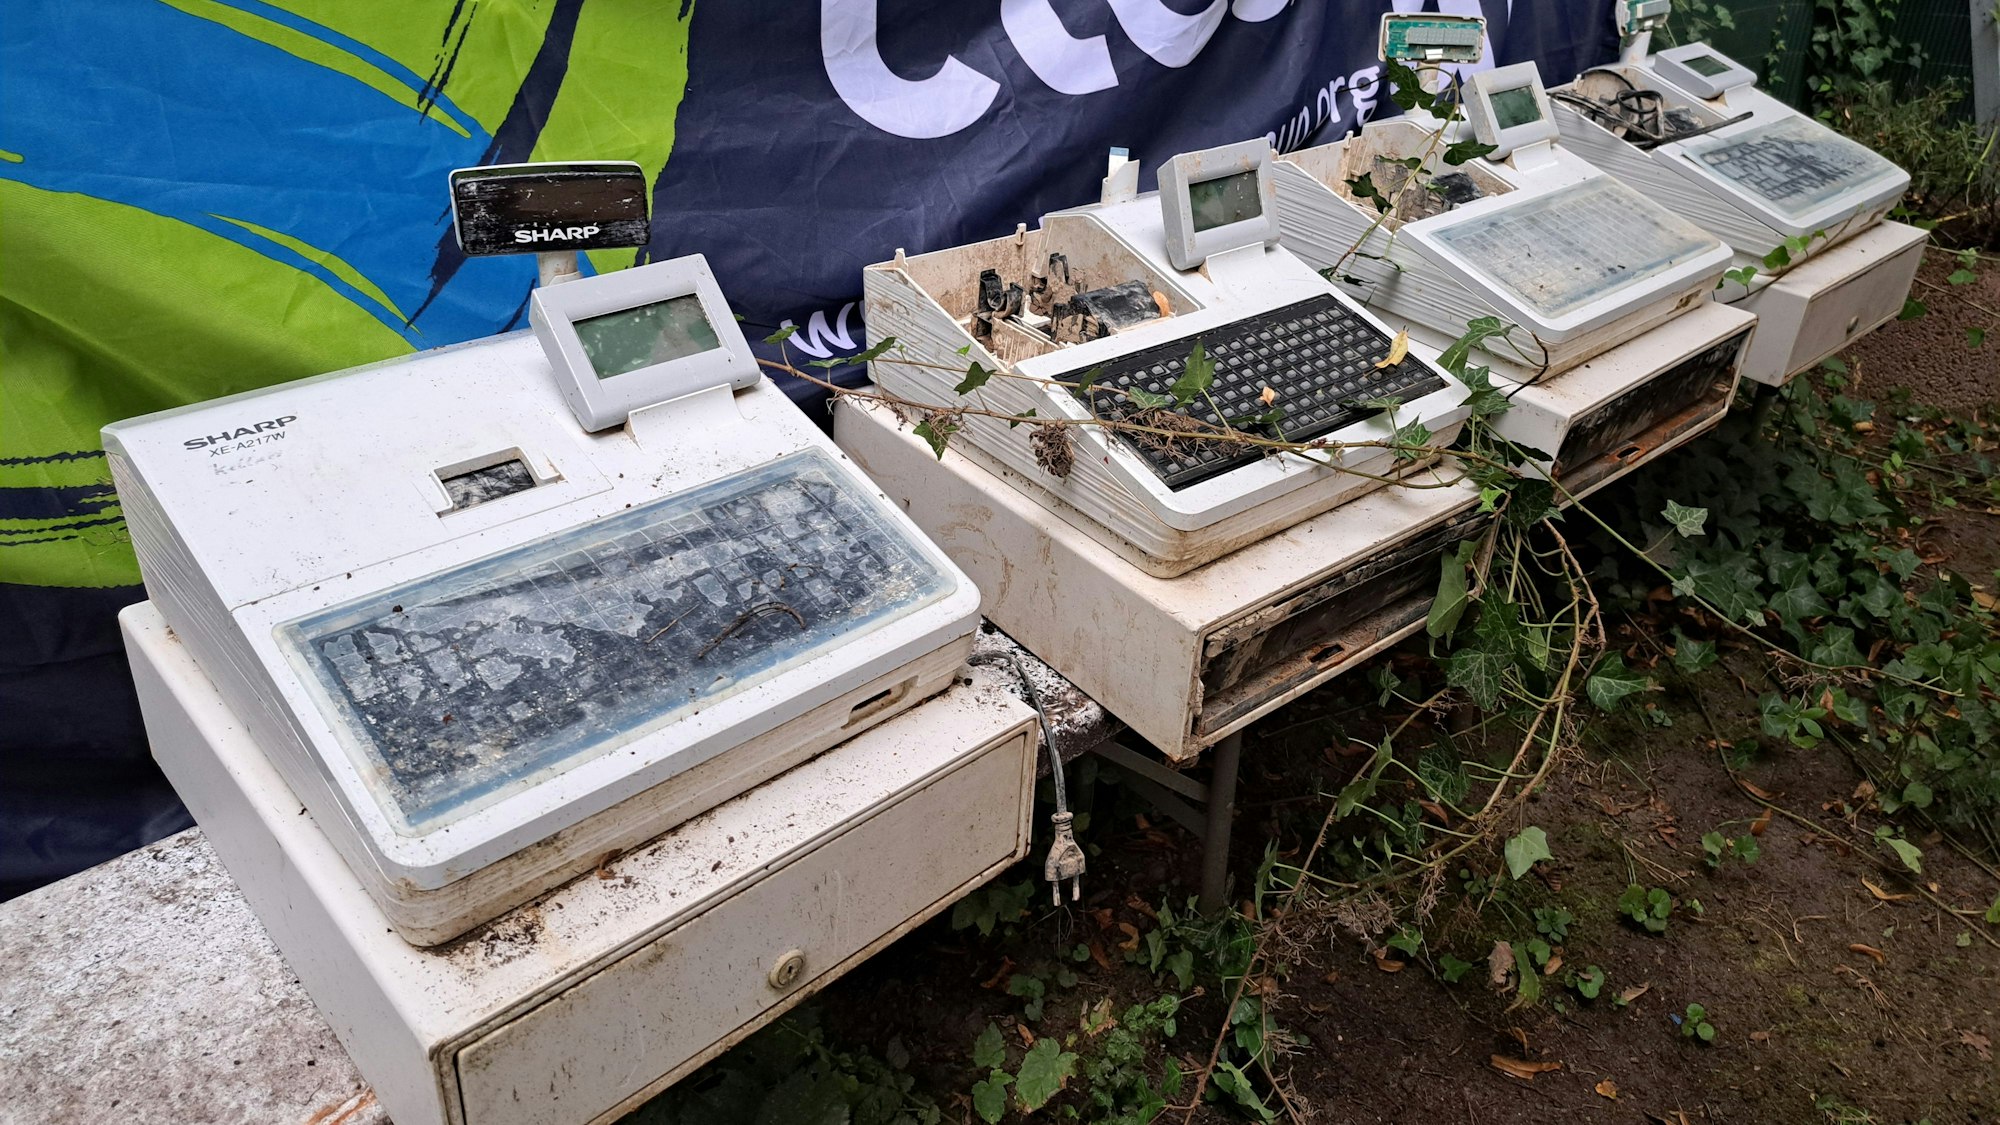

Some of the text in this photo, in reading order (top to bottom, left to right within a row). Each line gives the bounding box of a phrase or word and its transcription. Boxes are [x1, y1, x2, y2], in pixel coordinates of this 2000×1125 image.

[514, 225, 600, 243] SHARP
[183, 415, 298, 450] SHARP
[209, 431, 286, 458] XE-A217W
